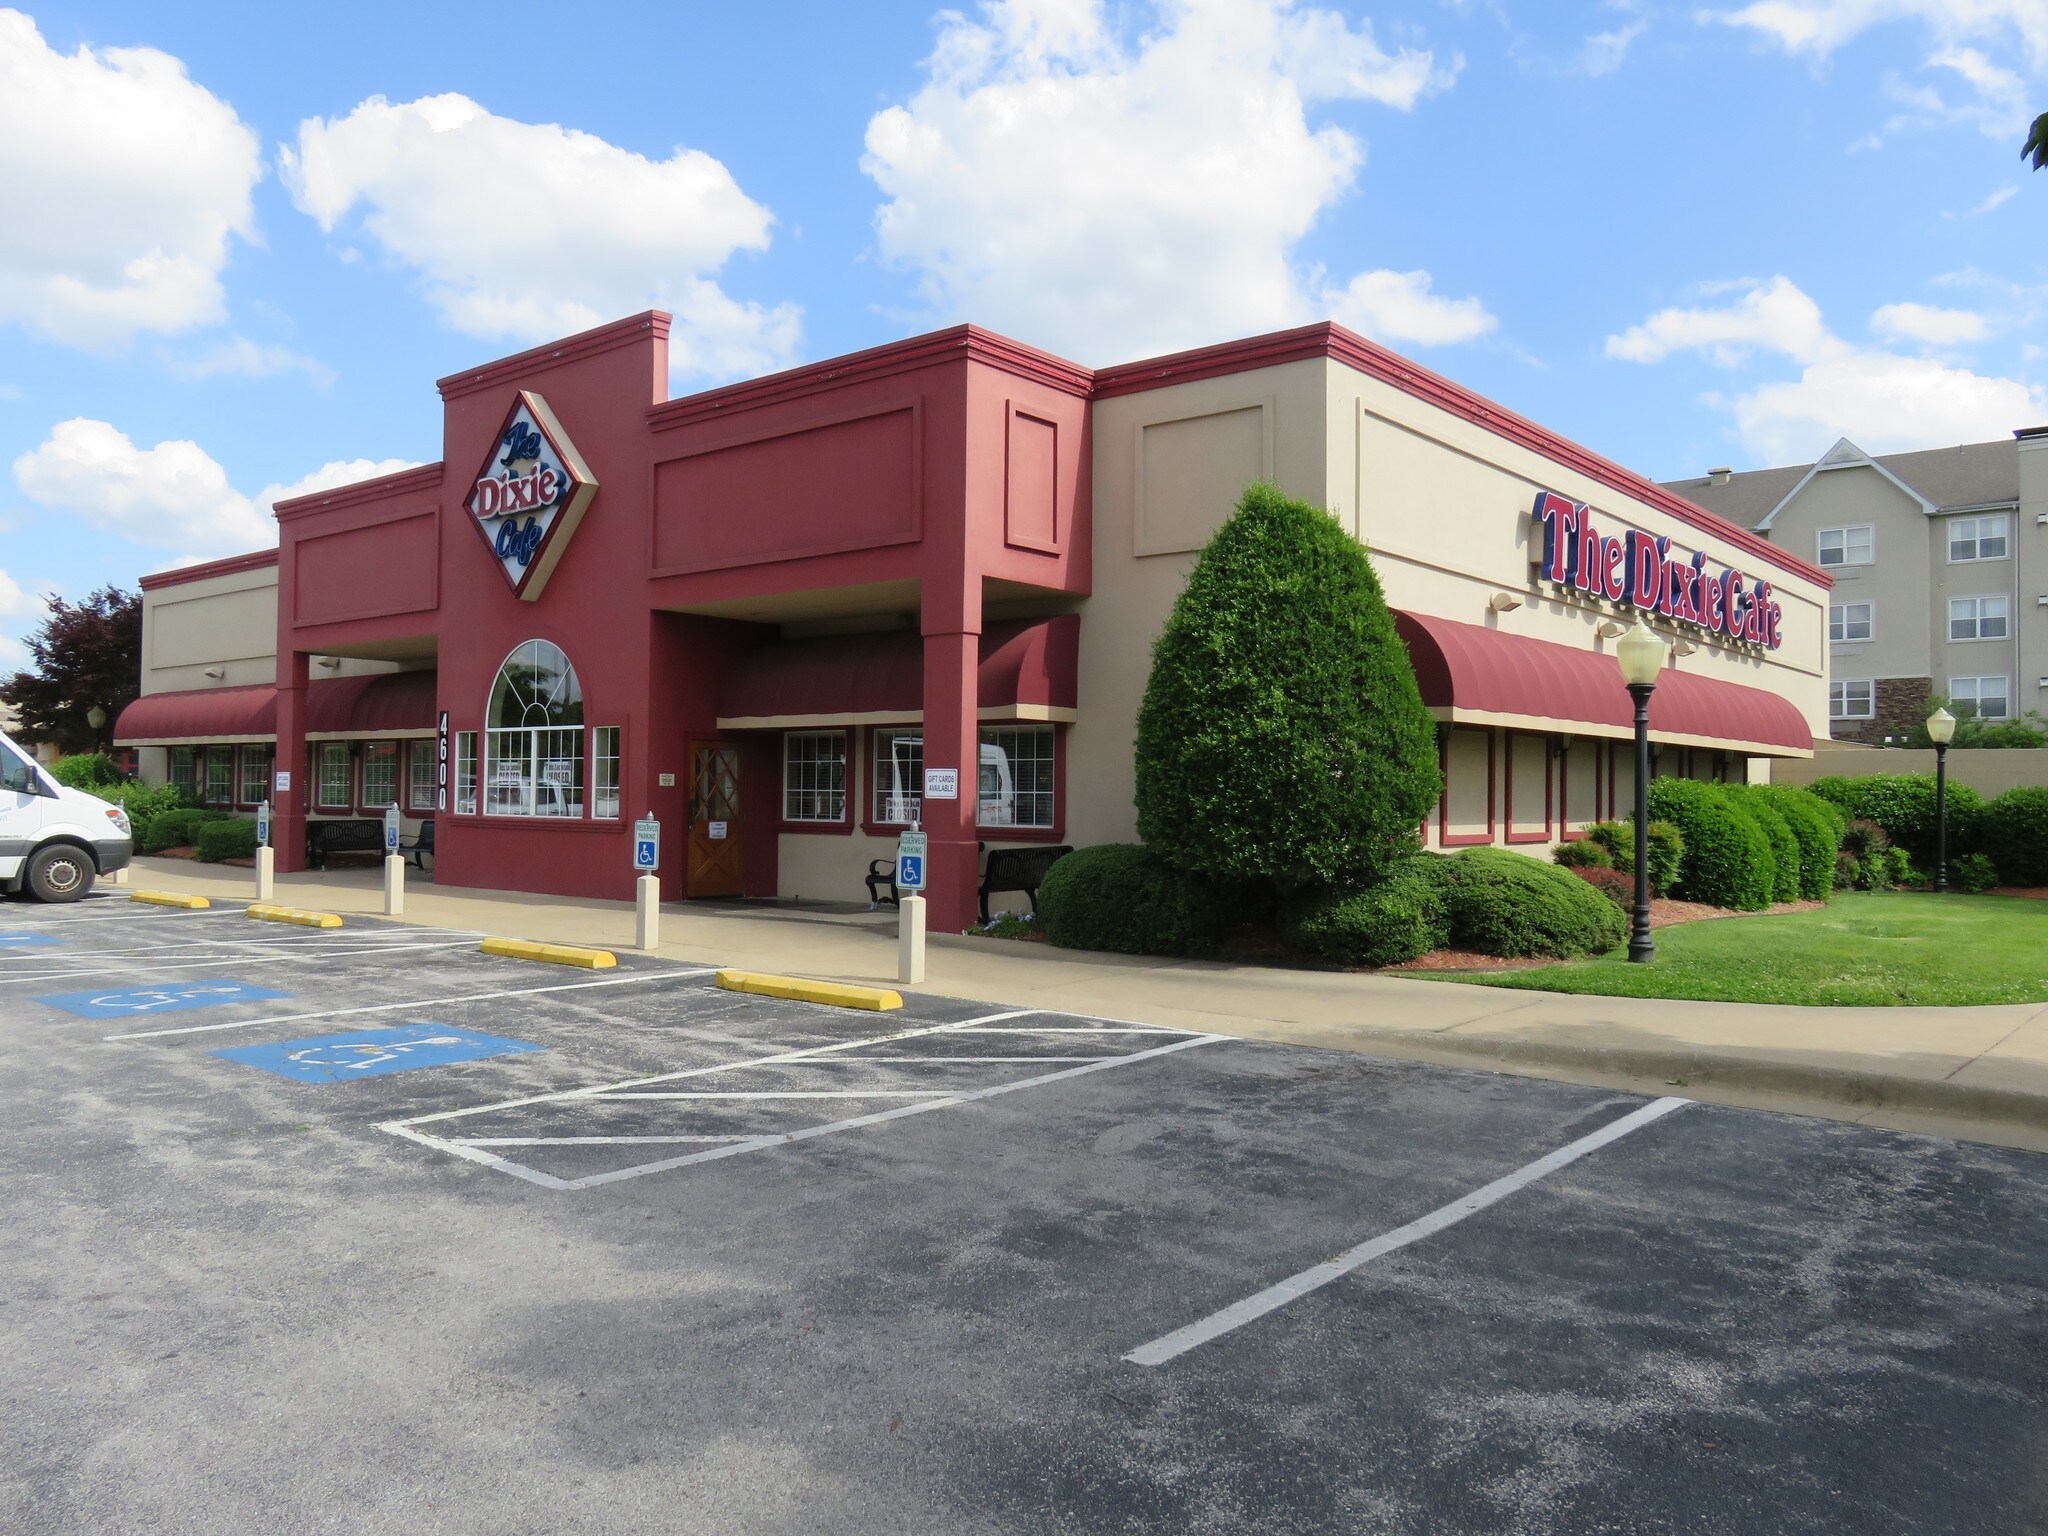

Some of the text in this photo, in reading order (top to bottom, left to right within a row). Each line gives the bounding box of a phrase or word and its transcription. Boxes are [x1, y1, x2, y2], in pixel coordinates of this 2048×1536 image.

[500, 421, 541, 465] The
[476, 461, 565, 520] Dixie
[495, 517, 542, 566] Cafe
[1532, 492, 1782, 650] The Dixie Cafe
[439, 712, 448, 811] 4600
[928, 775, 955, 783] GIFT CARDS
[928, 784, 954, 792] AVAILABLE
[900, 846, 922, 855] PARKING
